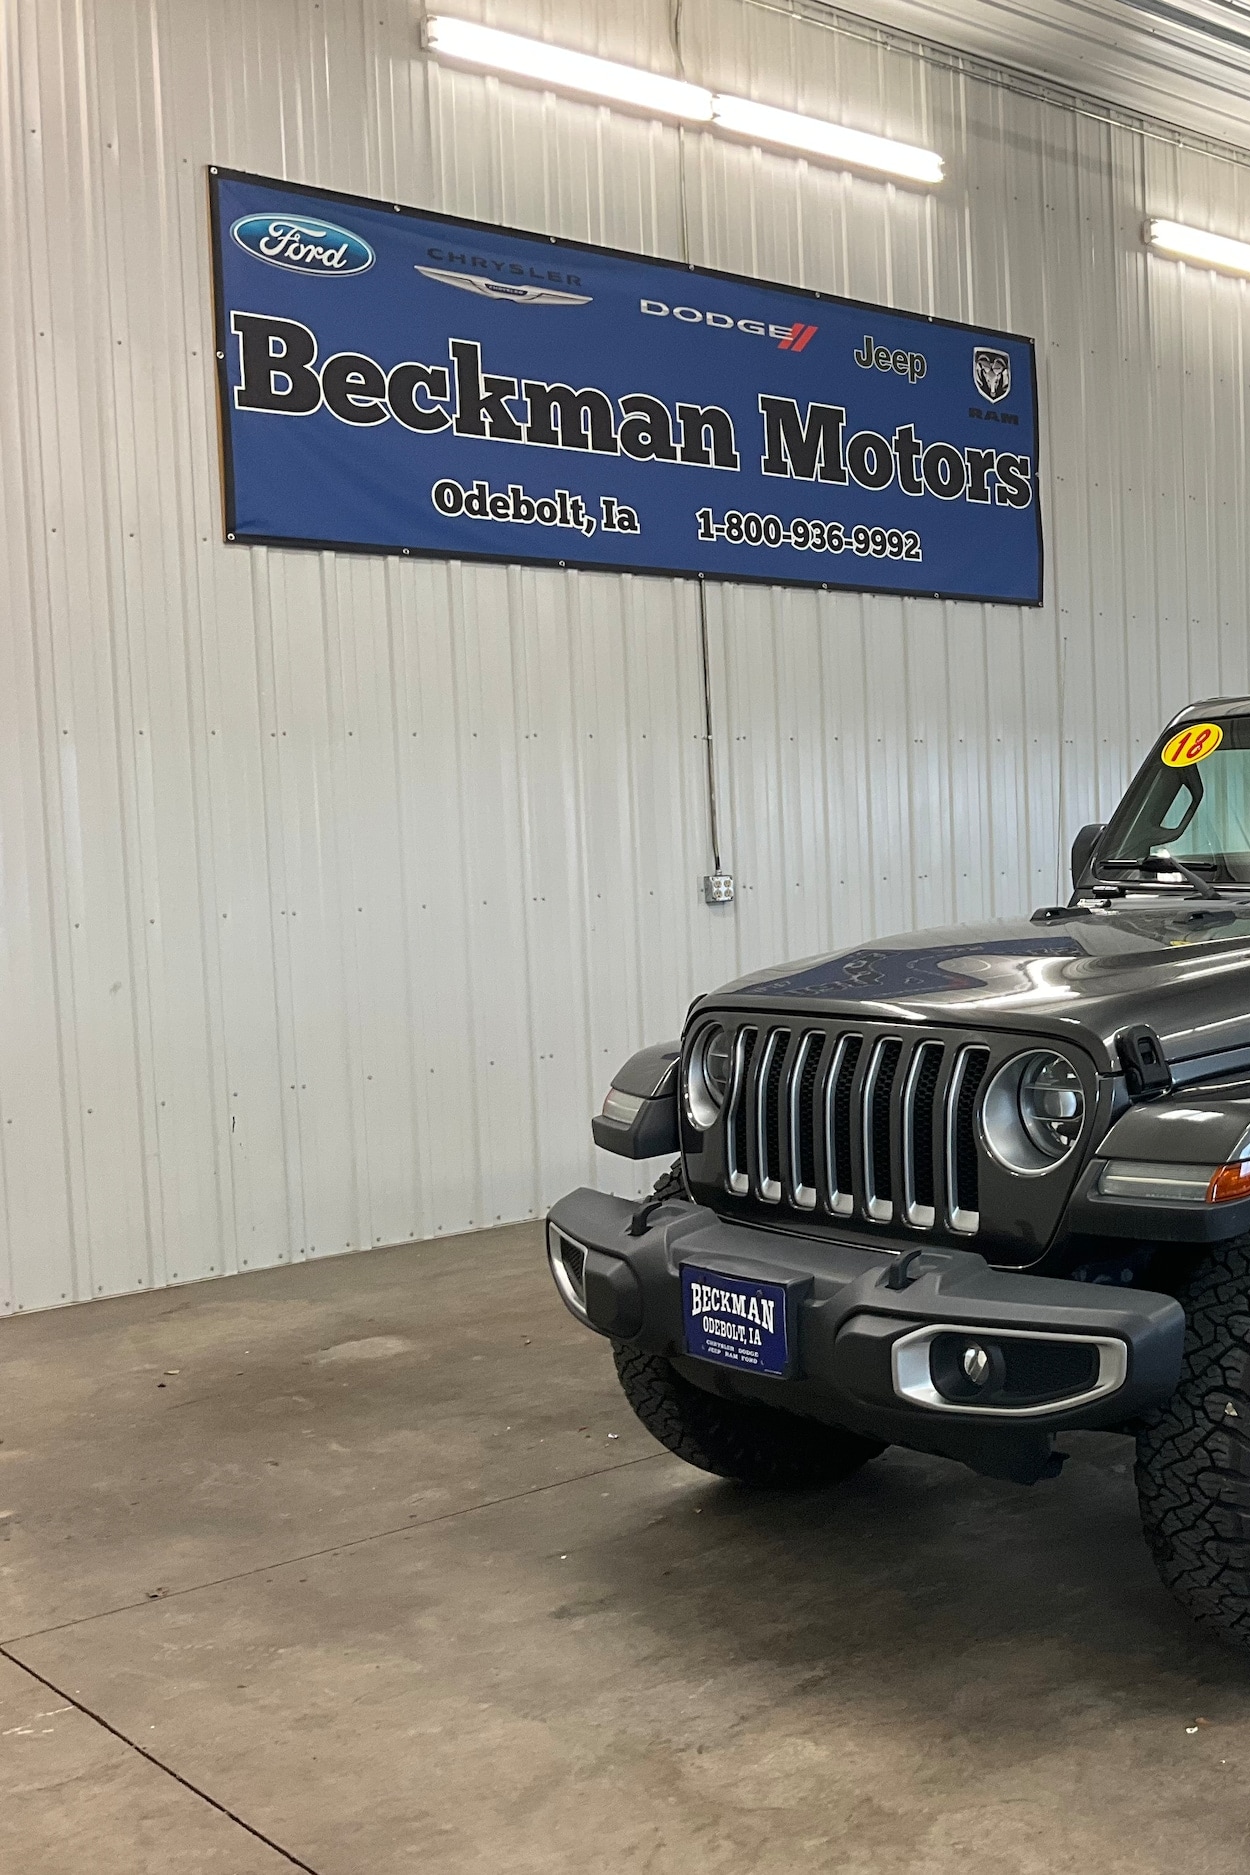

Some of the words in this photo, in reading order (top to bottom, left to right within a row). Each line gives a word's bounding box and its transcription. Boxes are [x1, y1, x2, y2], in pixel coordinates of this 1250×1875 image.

[258, 221, 347, 270] Ford
[427, 247, 582, 287] CHRYSLER
[639, 299, 795, 340] DODGE
[853, 335, 927, 383] Jeep
[230, 310, 740, 471] Beckman
[758, 393, 1032, 509] Motors
[968, 407, 1019, 426] RAM
[431, 479, 597, 537] Odebolt,
[601, 497, 641, 534] Ia
[696, 508, 922, 562] 1-800-936-9992
[1171, 728, 1211, 762] 18
[691, 1282, 775, 1334] BECKMAN
[703, 1315, 747, 1345] ODEBOLT,
[748, 1327, 762, 1346] IA
[705, 1339, 735, 1352] CHRYSLER
[738, 1347, 759, 1358] DODGE
[707, 1346, 722, 1355] JEEP
[724, 1351, 738, 1360] RAM
[741, 1355, 758, 1364] FORD
